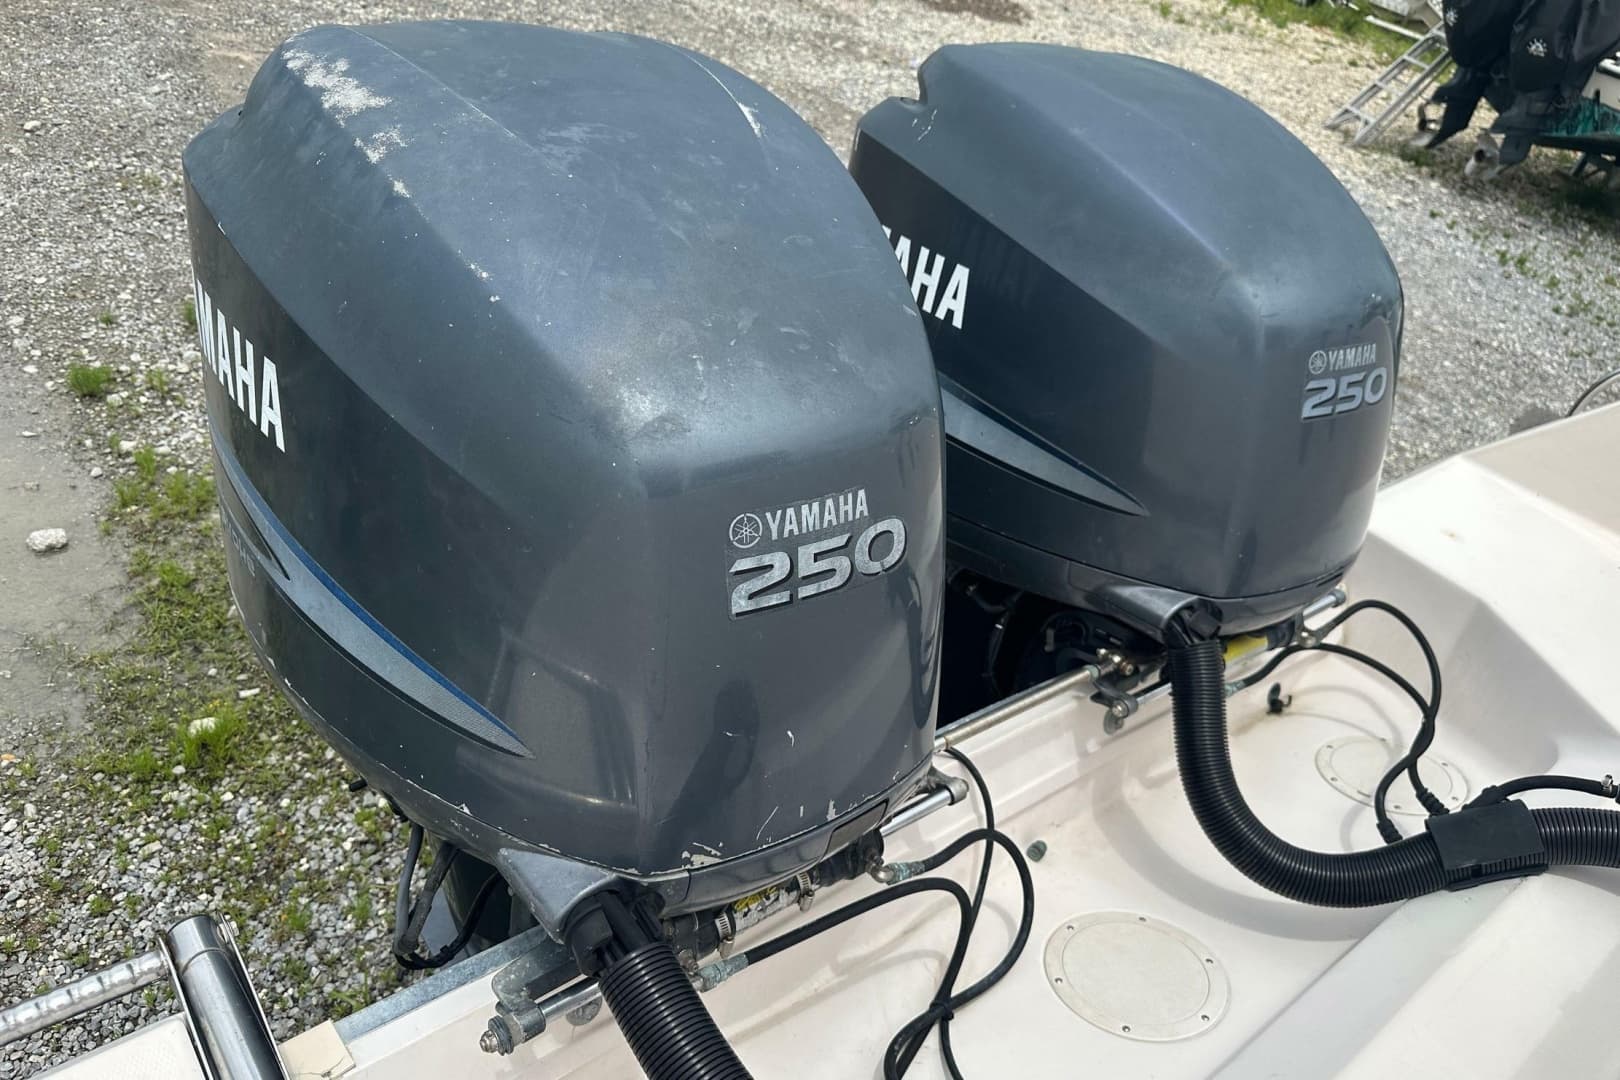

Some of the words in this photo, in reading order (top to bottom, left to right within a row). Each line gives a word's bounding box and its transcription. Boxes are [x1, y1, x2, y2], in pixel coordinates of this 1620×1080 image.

[881, 224, 970, 330] AHA
[1328, 343, 1377, 371] YAMAHA
[1301, 367, 1387, 420] 250
[765, 488, 869, 541] YAMAHA
[729, 518, 906, 617] 250
